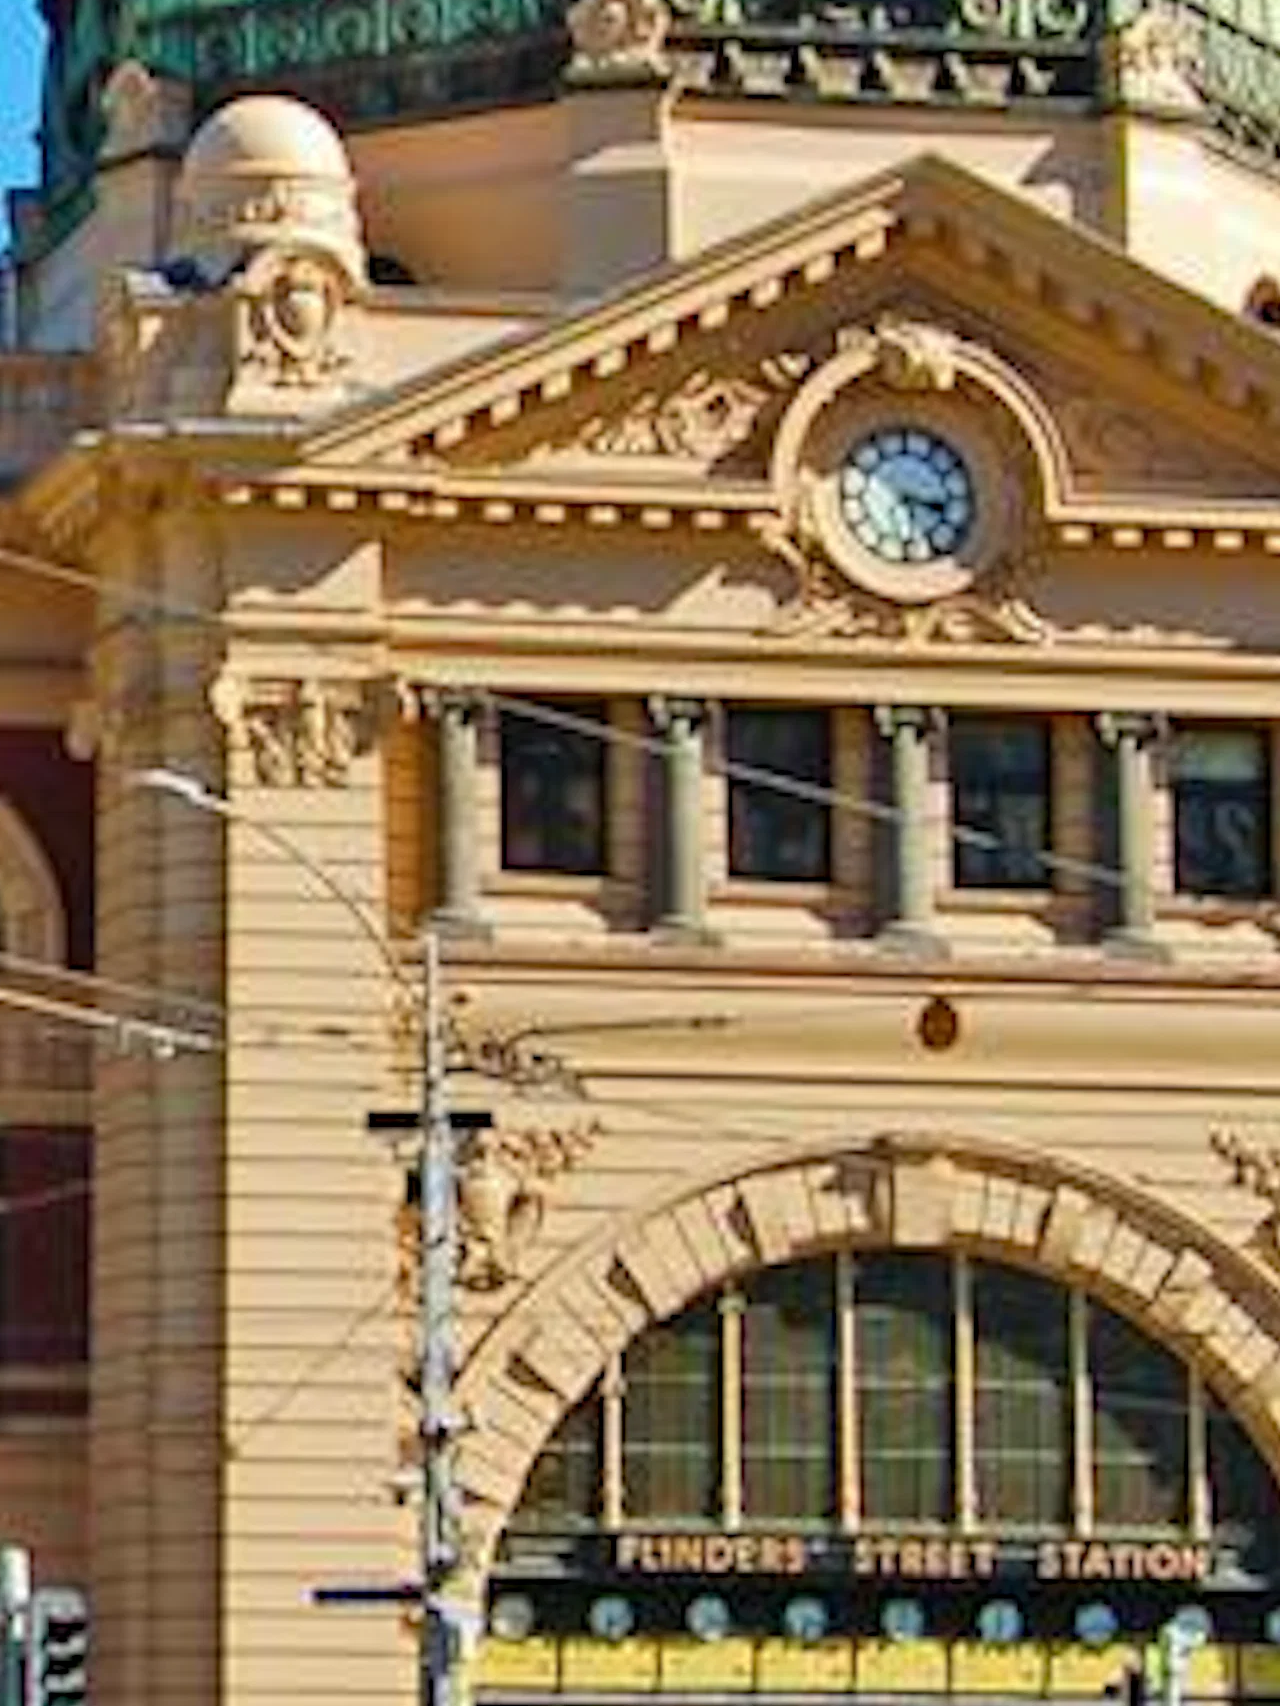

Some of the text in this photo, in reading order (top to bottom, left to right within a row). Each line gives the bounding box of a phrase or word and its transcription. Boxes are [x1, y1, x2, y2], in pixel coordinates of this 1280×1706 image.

[616, 1536, 1207, 1579] FLINDERS STREET STATION
